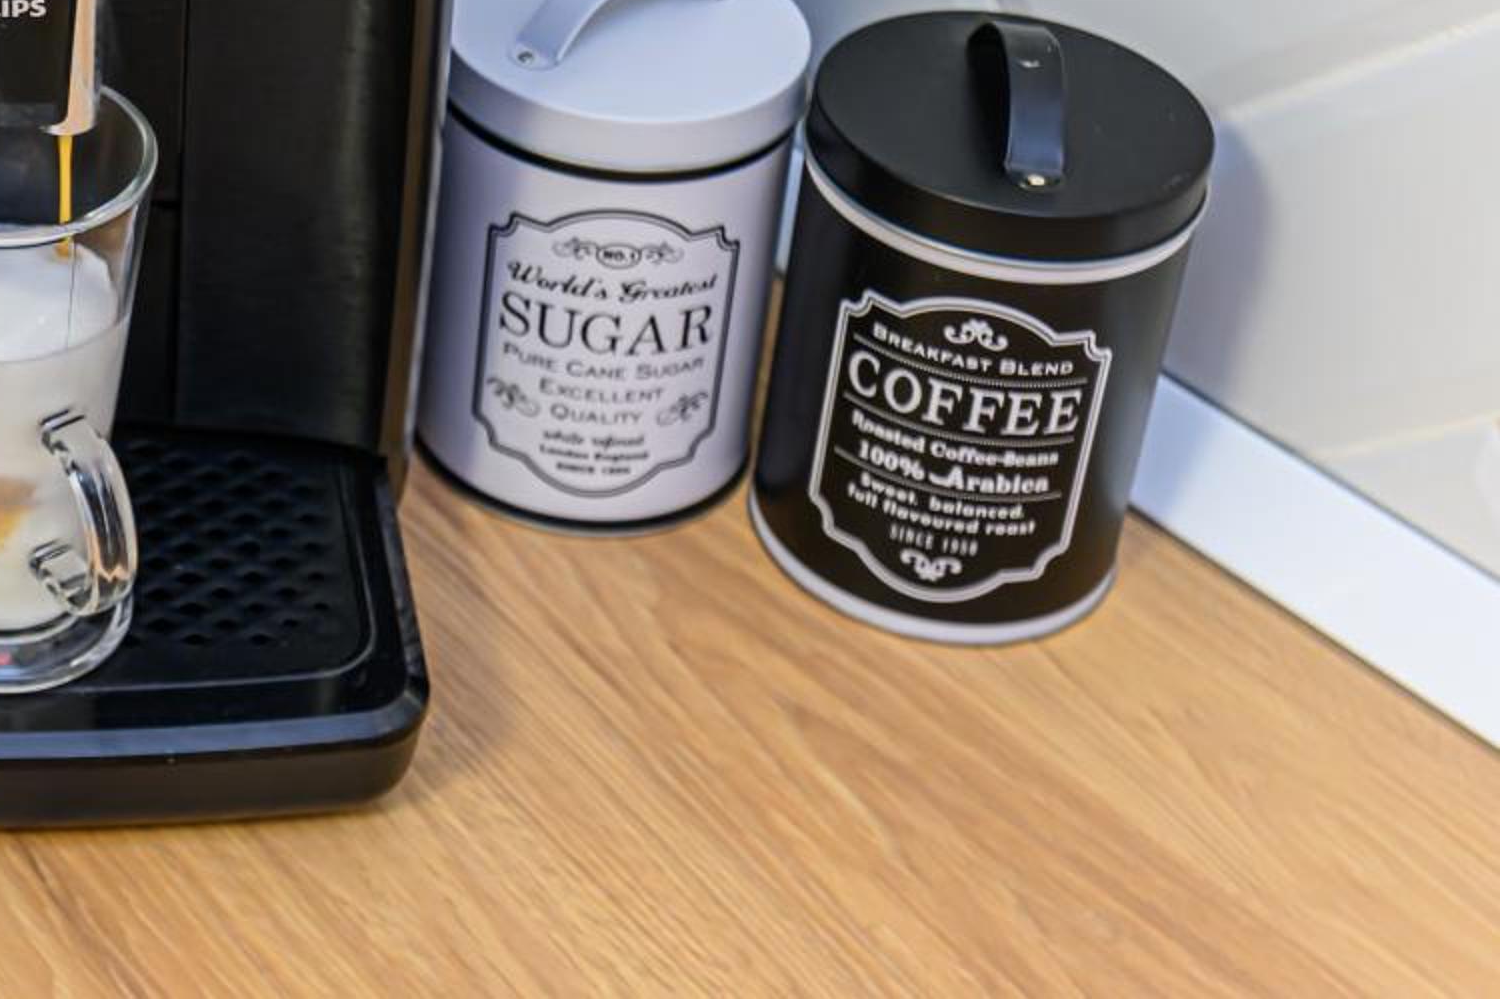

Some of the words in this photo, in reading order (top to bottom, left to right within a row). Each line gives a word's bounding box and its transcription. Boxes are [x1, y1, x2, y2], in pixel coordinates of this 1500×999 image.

[507, 261, 608, 299] World's
[619, 273, 718, 302] Greatest
[500, 290, 713, 356] SUGAR
[873, 321, 992, 373] BREAKFAST
[999, 359, 1074, 376] BLEND
[550, 403, 643, 425] QUALITY
[848, 351, 1083, 436] COFFEE
[852, 409, 927, 453] Roasted
[859, 440, 926, 481] 100%
[848, 482, 878, 508] full
[882, 499, 980, 534] flavoured
[985, 520, 1036, 536] roast
